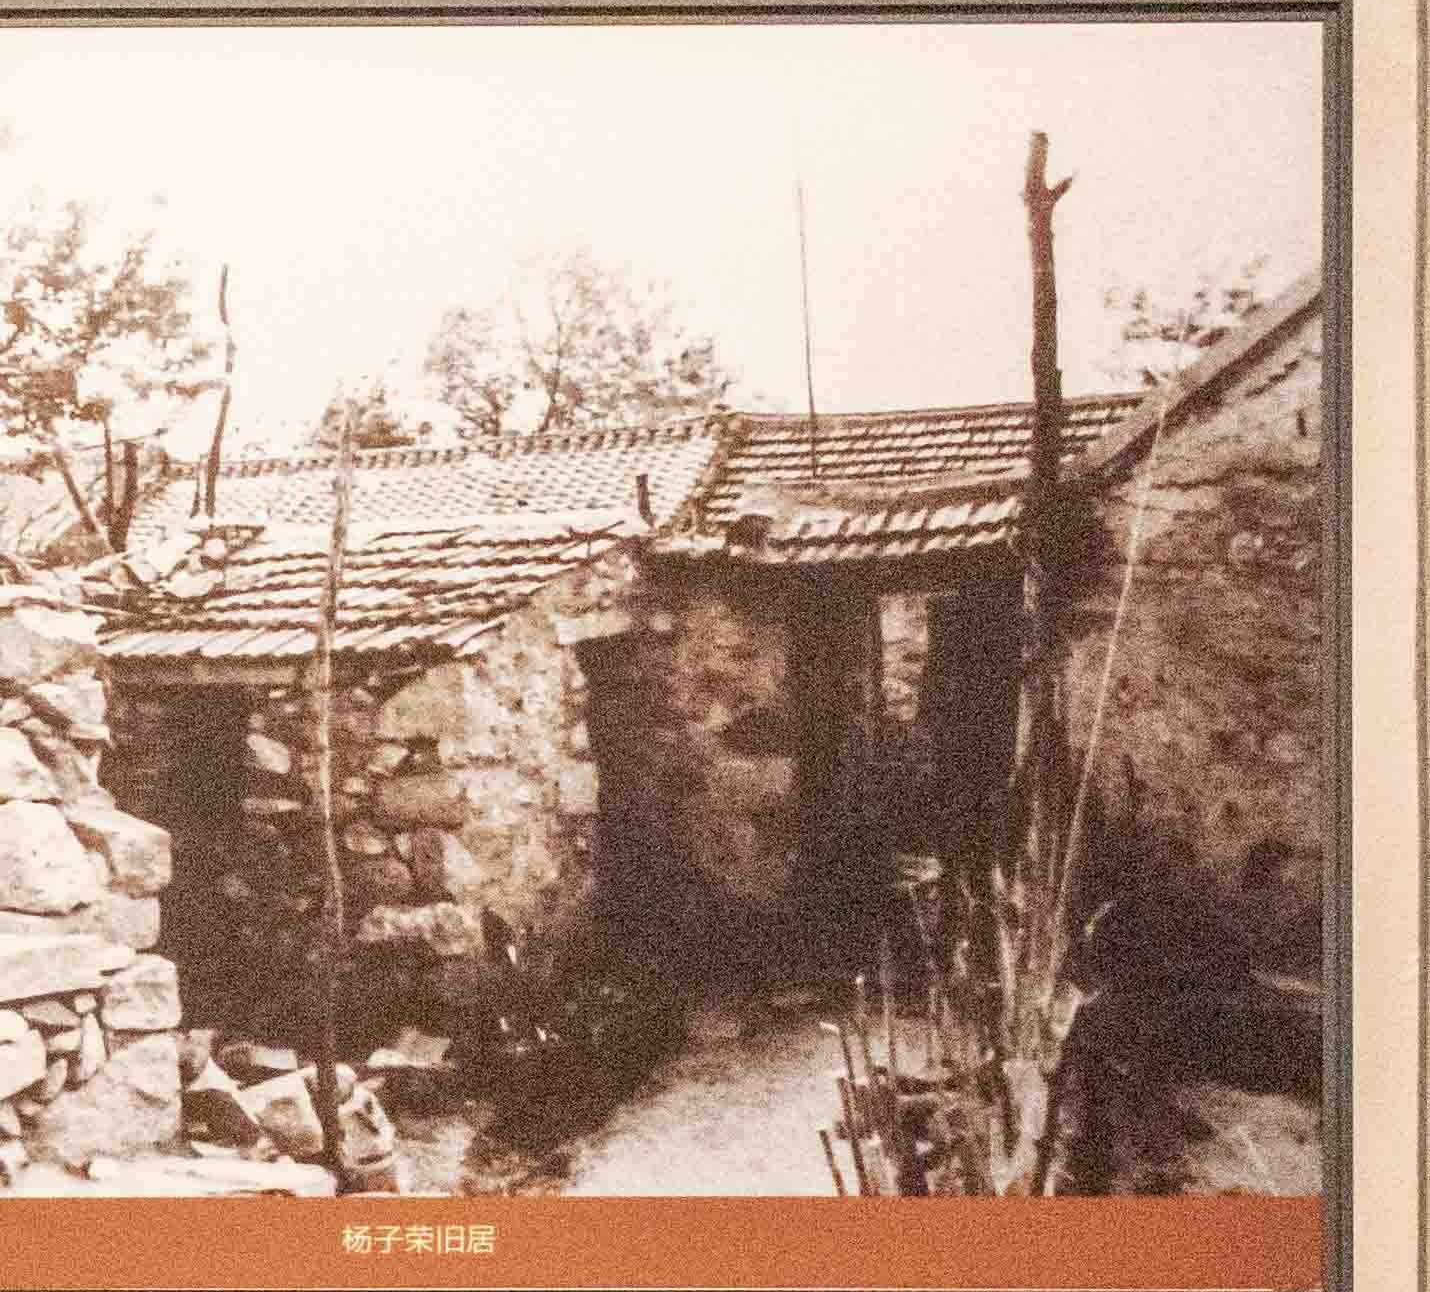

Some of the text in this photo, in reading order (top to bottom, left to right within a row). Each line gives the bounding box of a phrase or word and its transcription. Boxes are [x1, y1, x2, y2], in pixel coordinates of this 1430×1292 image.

[341, 1223, 496, 1255] 杨子荣旧居
